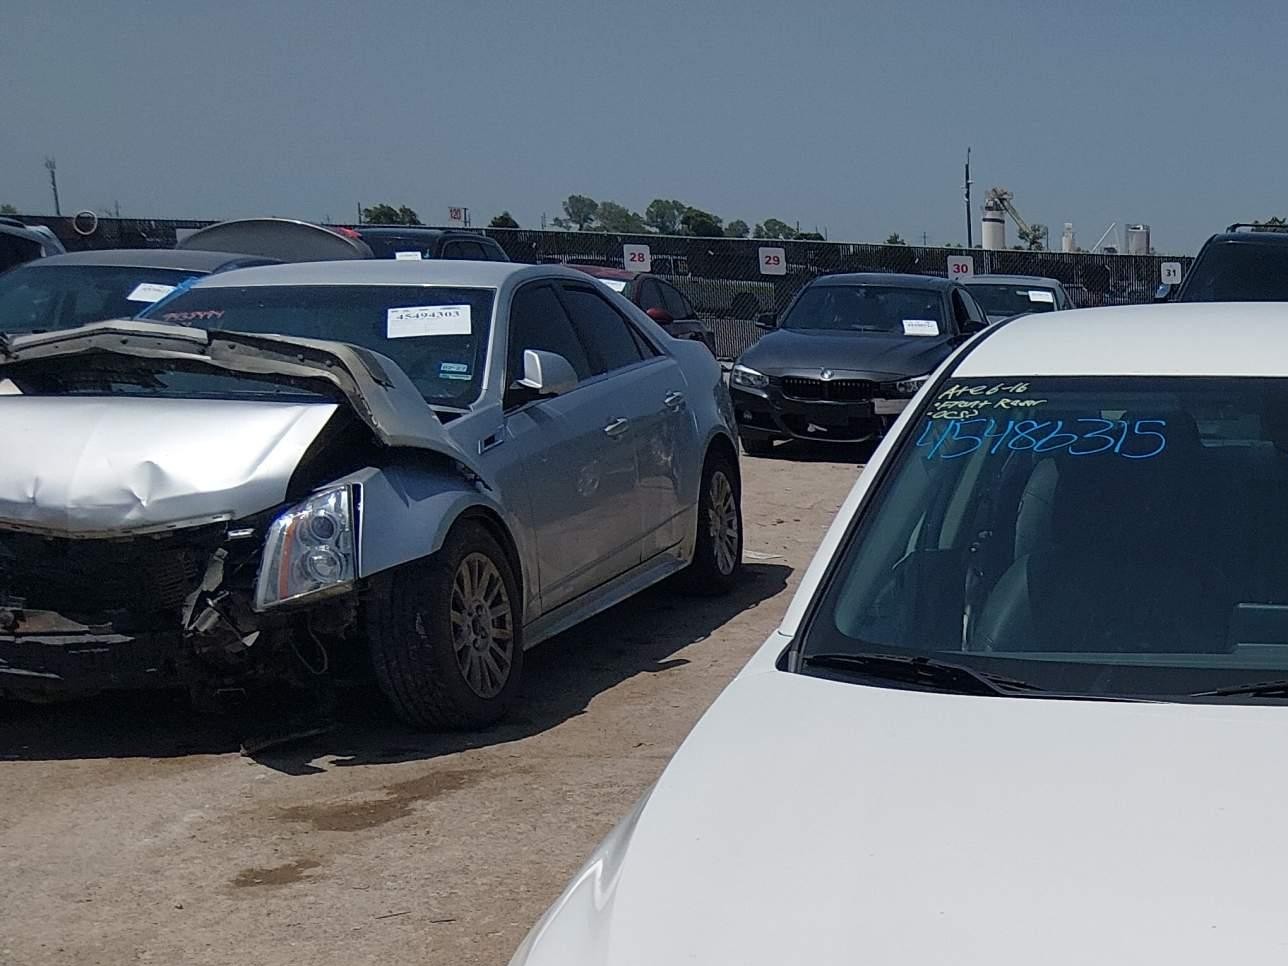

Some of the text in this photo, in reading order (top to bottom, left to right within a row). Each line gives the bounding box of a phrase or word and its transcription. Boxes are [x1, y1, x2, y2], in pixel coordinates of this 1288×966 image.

[629, 251, 646, 263] 28
[764, 255, 780, 266] 29
[952, 263, 969, 274] 30
[1165, 268, 1177, 278] 31
[916, 417, 1167, 460] 45486315
